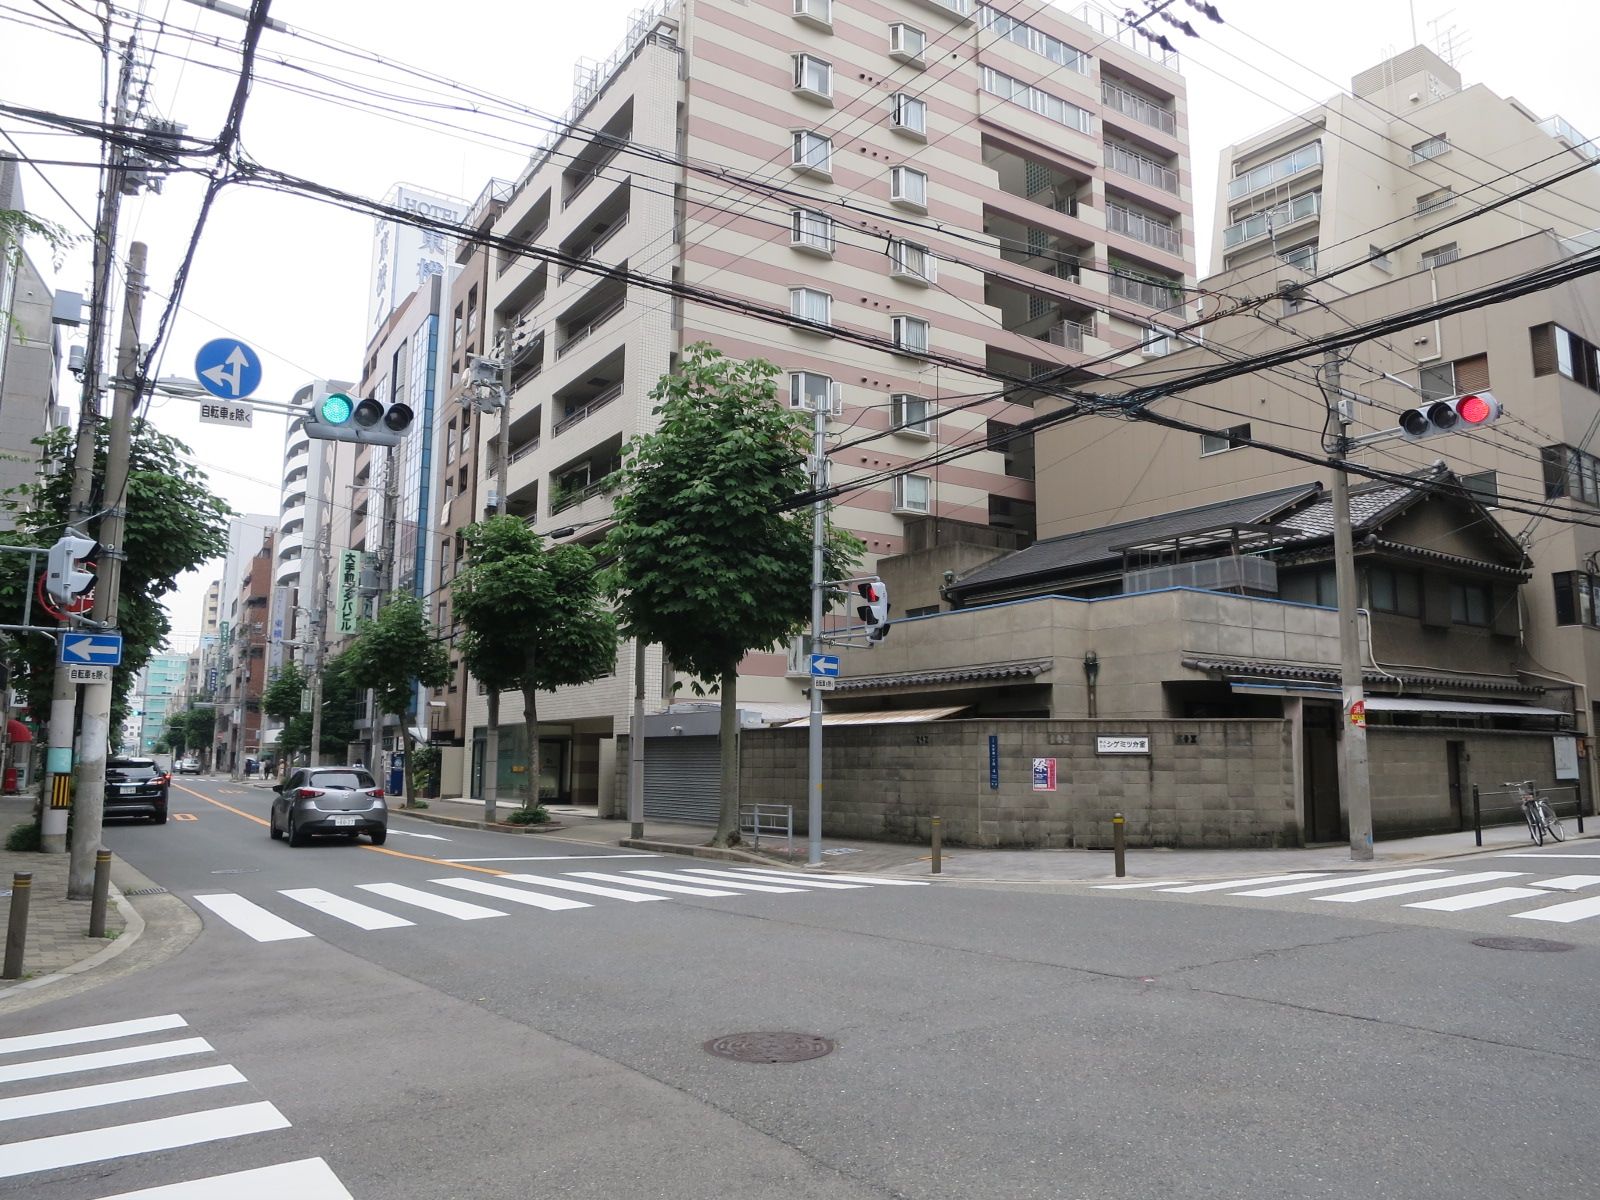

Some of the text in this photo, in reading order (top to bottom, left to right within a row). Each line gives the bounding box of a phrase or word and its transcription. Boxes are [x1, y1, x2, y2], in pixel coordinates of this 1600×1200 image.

[403, 196, 458, 222] HOTEL
[202, 404, 251, 422] 自転車を除く
[70, 668, 109, 681] 自転車を除く
[1033, 758, 1048, 773] 祭
